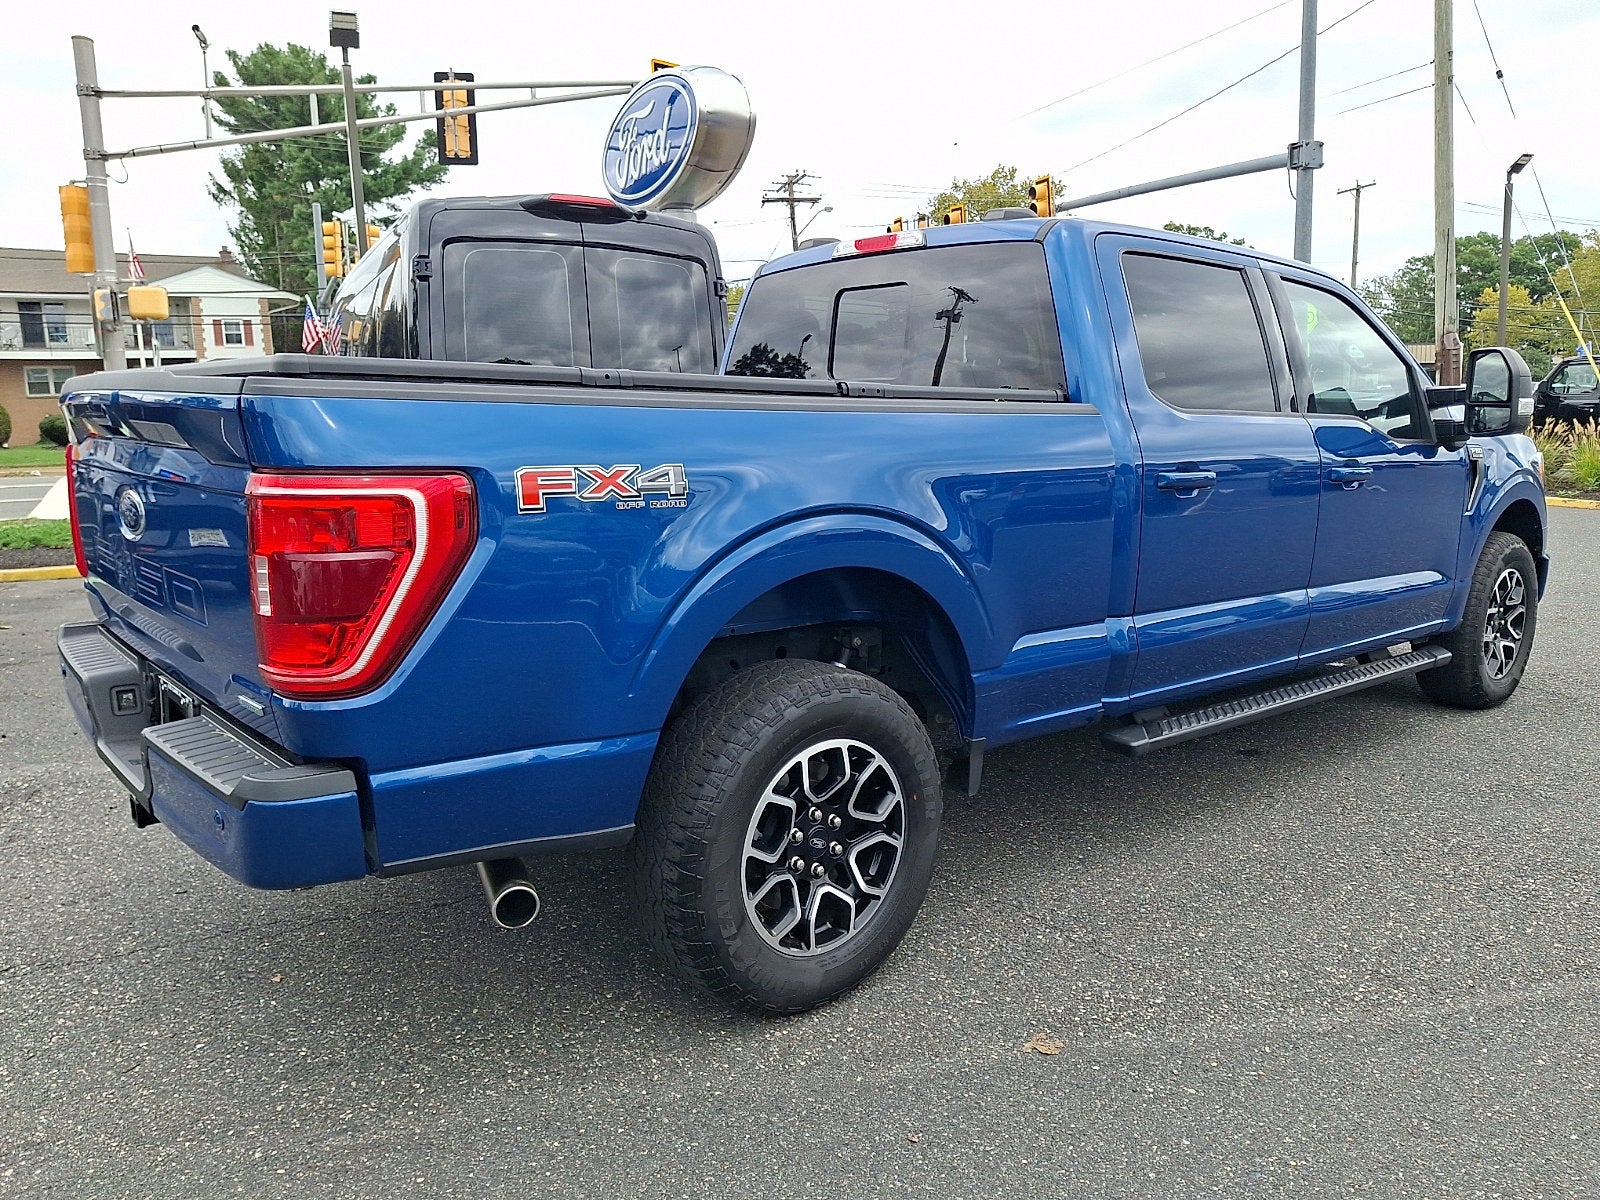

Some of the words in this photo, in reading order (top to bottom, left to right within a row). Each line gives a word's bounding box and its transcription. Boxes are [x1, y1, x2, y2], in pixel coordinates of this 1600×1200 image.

[615, 99, 672, 190] Ford
[514, 464, 688, 514] FX4
[615, 501, 646, 510] OFF
[649, 500, 687, 508] ROAD
